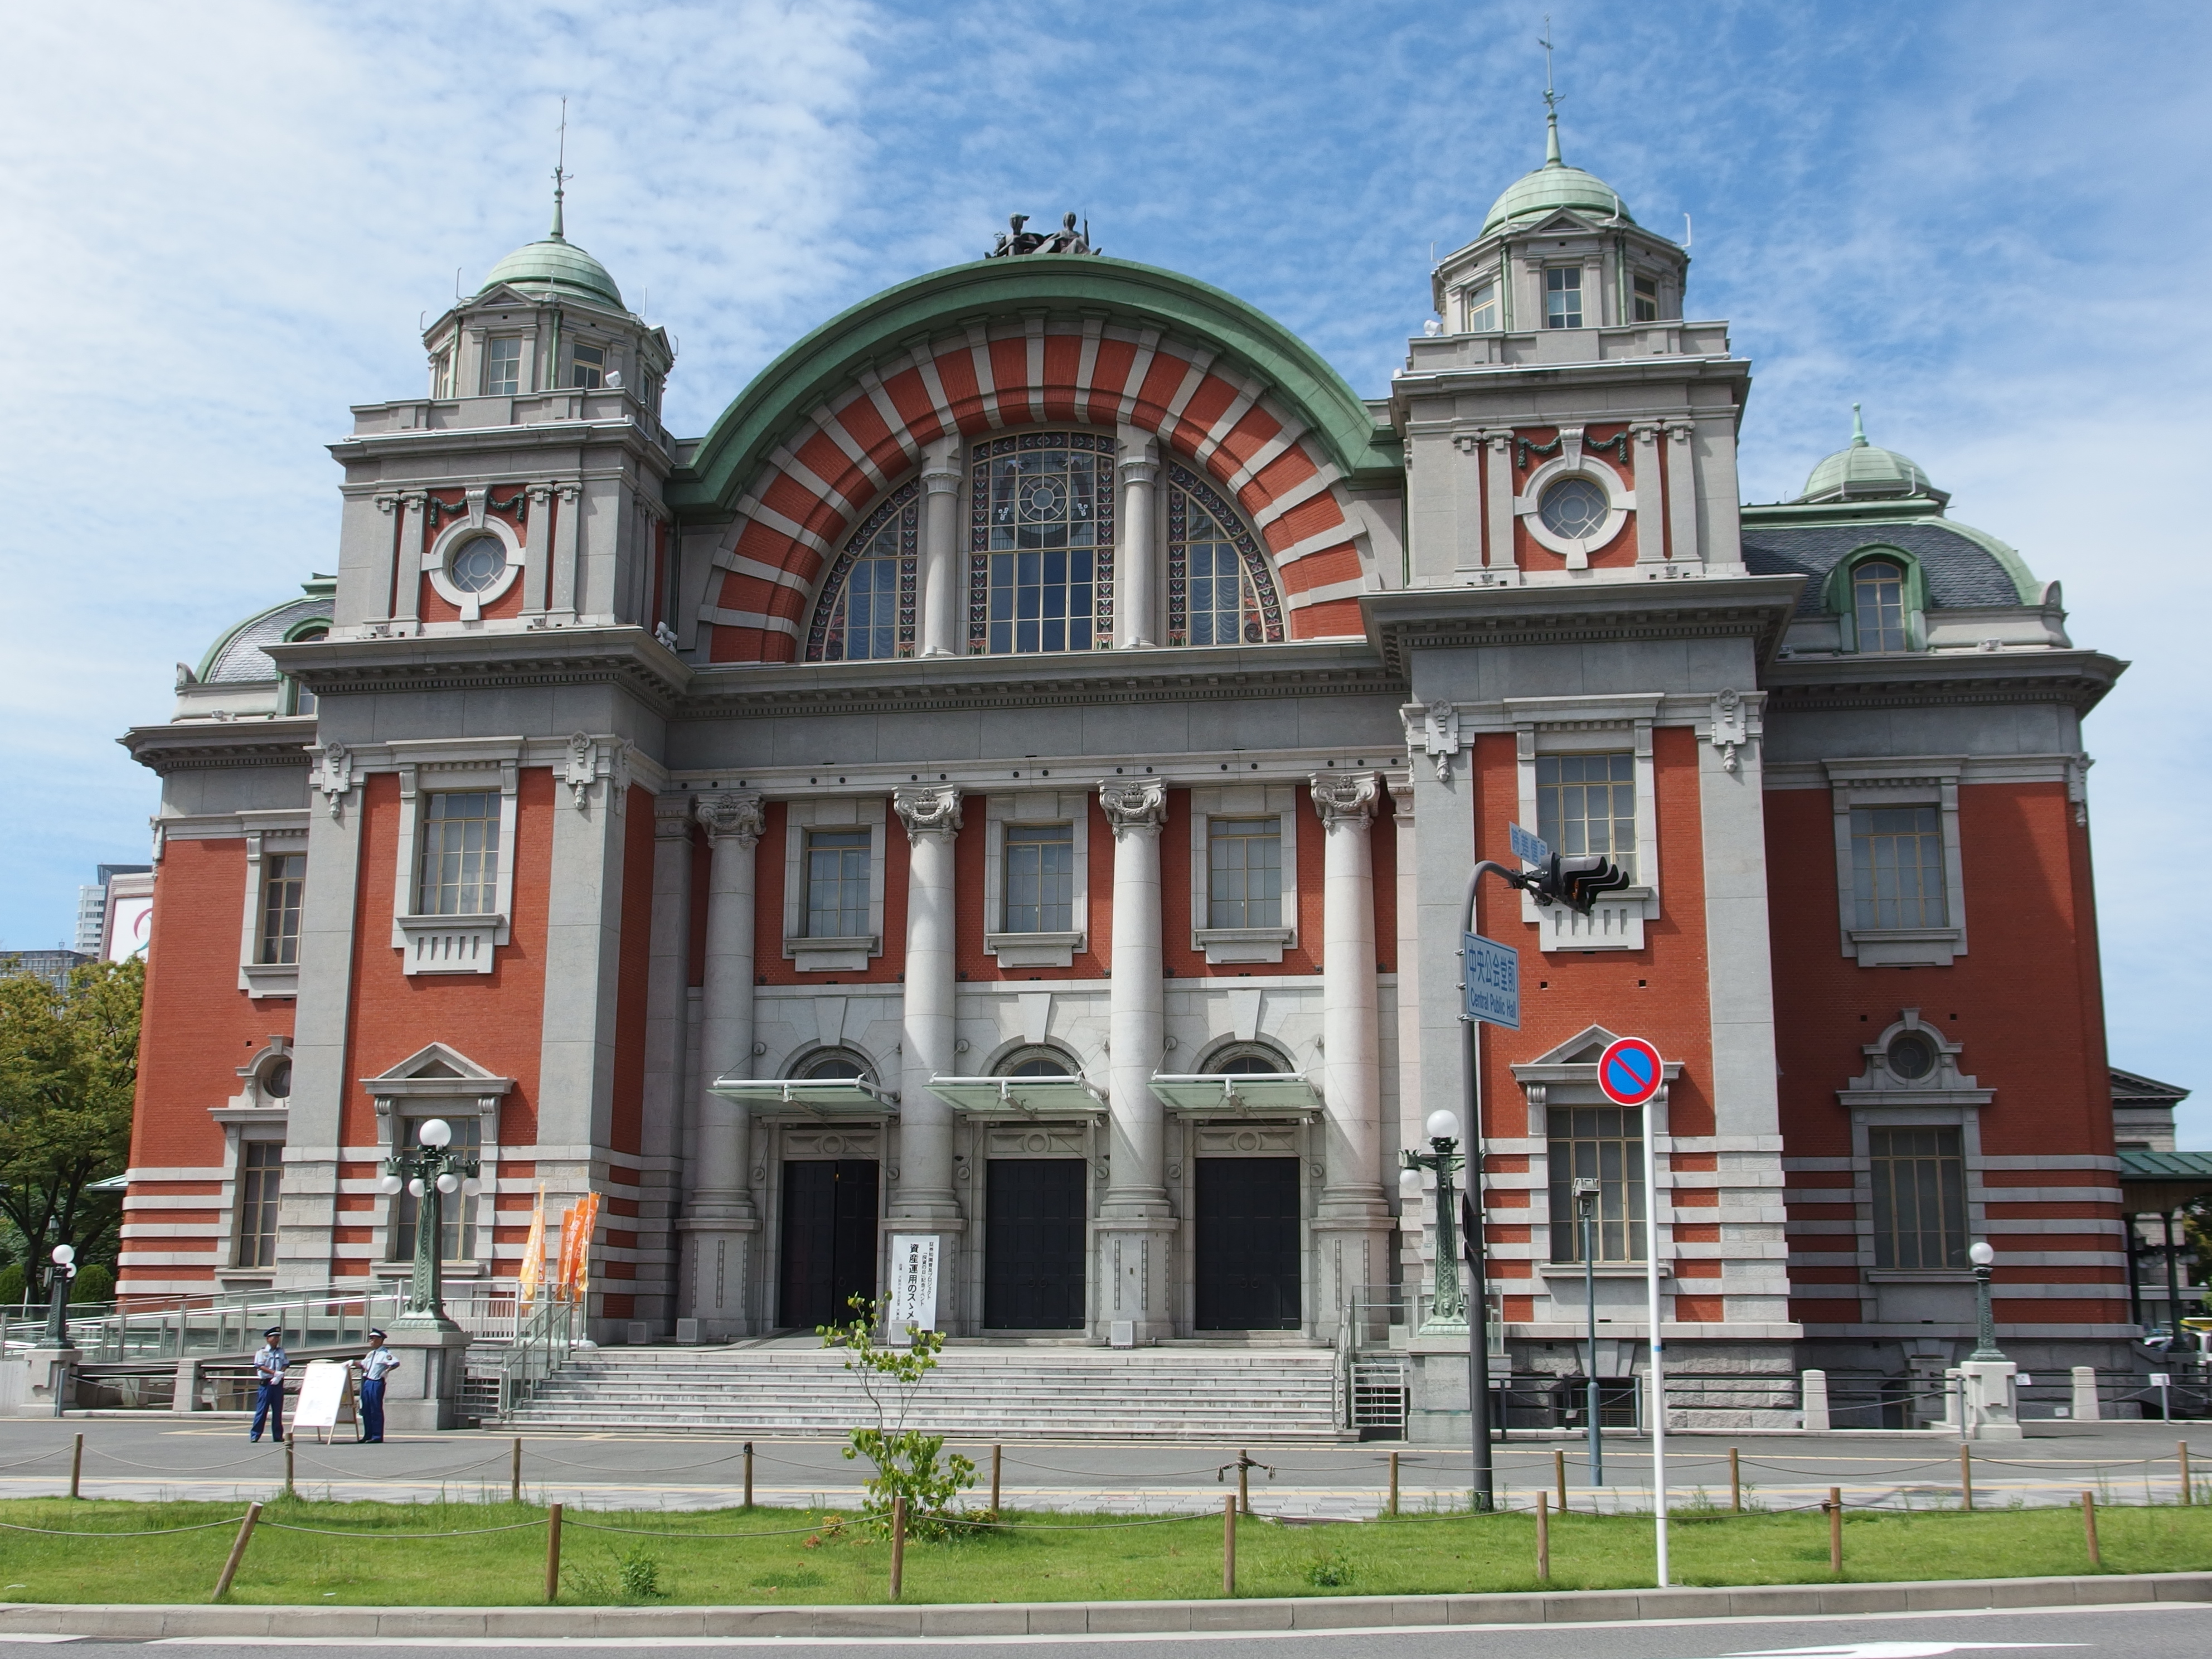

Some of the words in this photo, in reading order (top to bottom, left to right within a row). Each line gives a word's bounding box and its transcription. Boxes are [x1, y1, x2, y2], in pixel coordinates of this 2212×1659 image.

[1469, 943, 1515, 993] 中央公会堂前
[1471, 987, 1489, 1011] Central
[1490, 993, 1506, 1015] Public
[1507, 998, 1516, 1018] Hall
